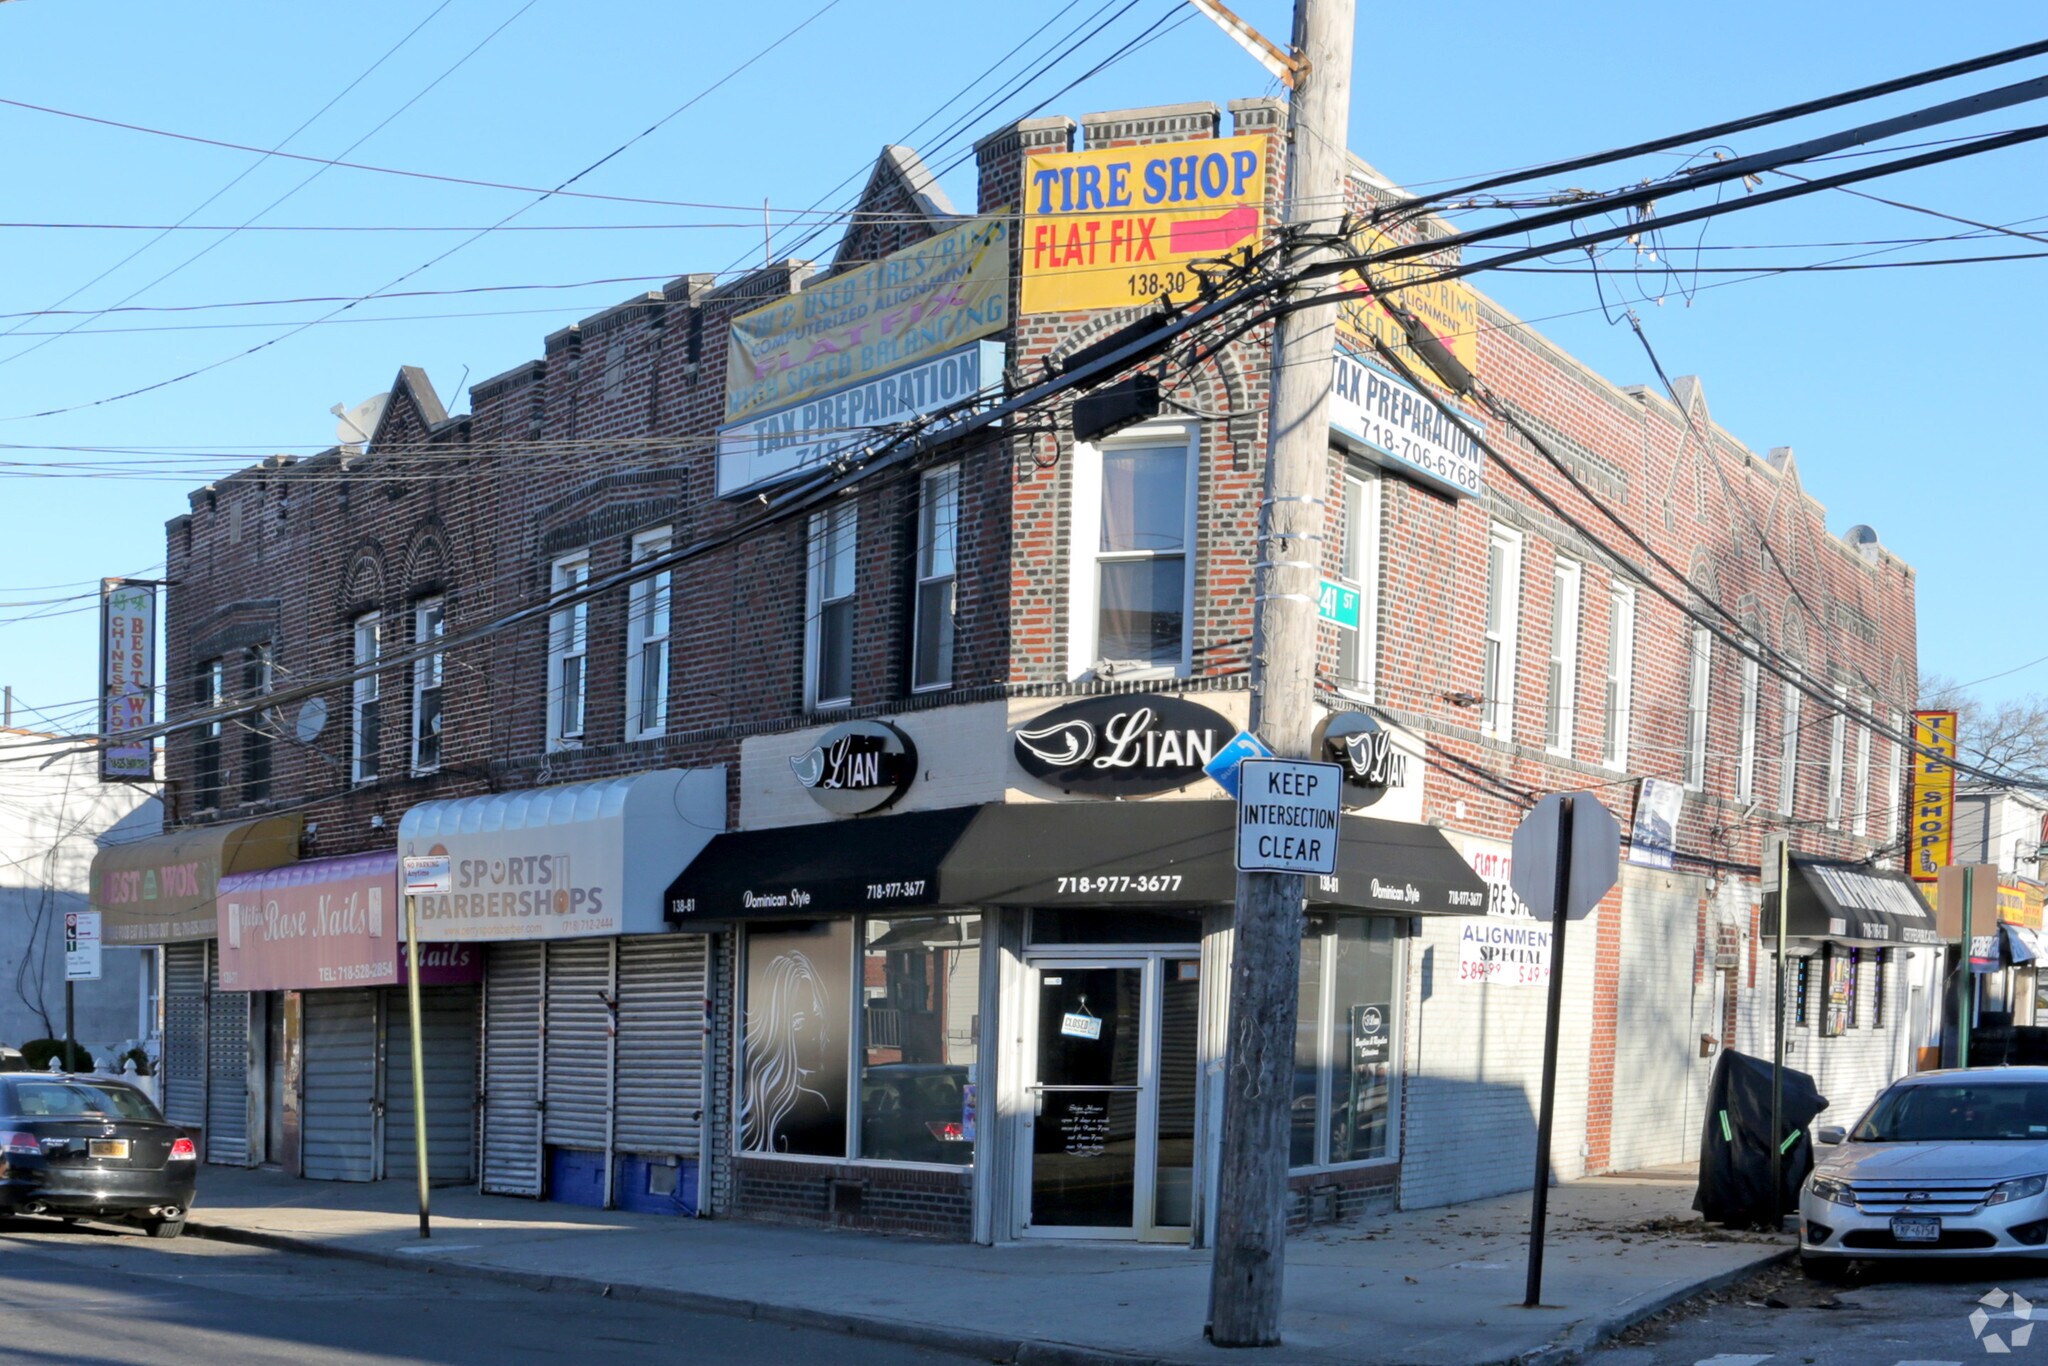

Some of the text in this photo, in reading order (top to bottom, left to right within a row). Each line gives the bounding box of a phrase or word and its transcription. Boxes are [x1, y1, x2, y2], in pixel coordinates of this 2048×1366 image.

[1034, 150, 1257, 214] TIRE SHOP
[1034, 217, 1156, 269] FLAT FIX
[804, 278, 856, 320] USED
[1128, 272, 1185, 296] 138-30
[751, 304, 868, 358] COMPUTERIZED
[753, 284, 967, 380] FLAT FIX
[861, 294, 1003, 372] BALANCING
[1398, 289, 1462, 336] ALIGNMENT
[753, 414, 797, 457] TAX
[803, 350, 977, 442] PREPARATION
[1366, 372, 1480, 464] PREPARATION
[1361, 416, 1477, 490] 718-706-6768
[112, 617, 124, 695] CHINESE
[131, 617, 145, 687] BEST
[1093, 707, 1213, 768] LIAN
[1269, 772, 1318, 796] KEEP
[1244, 805, 1335, 829] INTERSECTION
[1920, 791, 1942, 847] SHOP
[1258, 835, 1321, 861] CLEAR
[161, 862, 199, 898] WOK
[743, 890, 787, 908] Dominican
[790, 889, 811, 908] Style
[867, 880, 925, 899] 718-977-3677
[1057, 875, 1183, 893] 718-977-3677
[1371, 878, 1404, 901] Dominican
[1405, 884, 1420, 904] Style
[312, 892, 366, 937] Nails
[1463, 925, 1553, 947] ALIGNMEN
[319, 967, 337, 982] TEL:
[1480, 946, 1543, 965] SPECIAL
[1065, 1017, 1089, 1030] CLOSED
